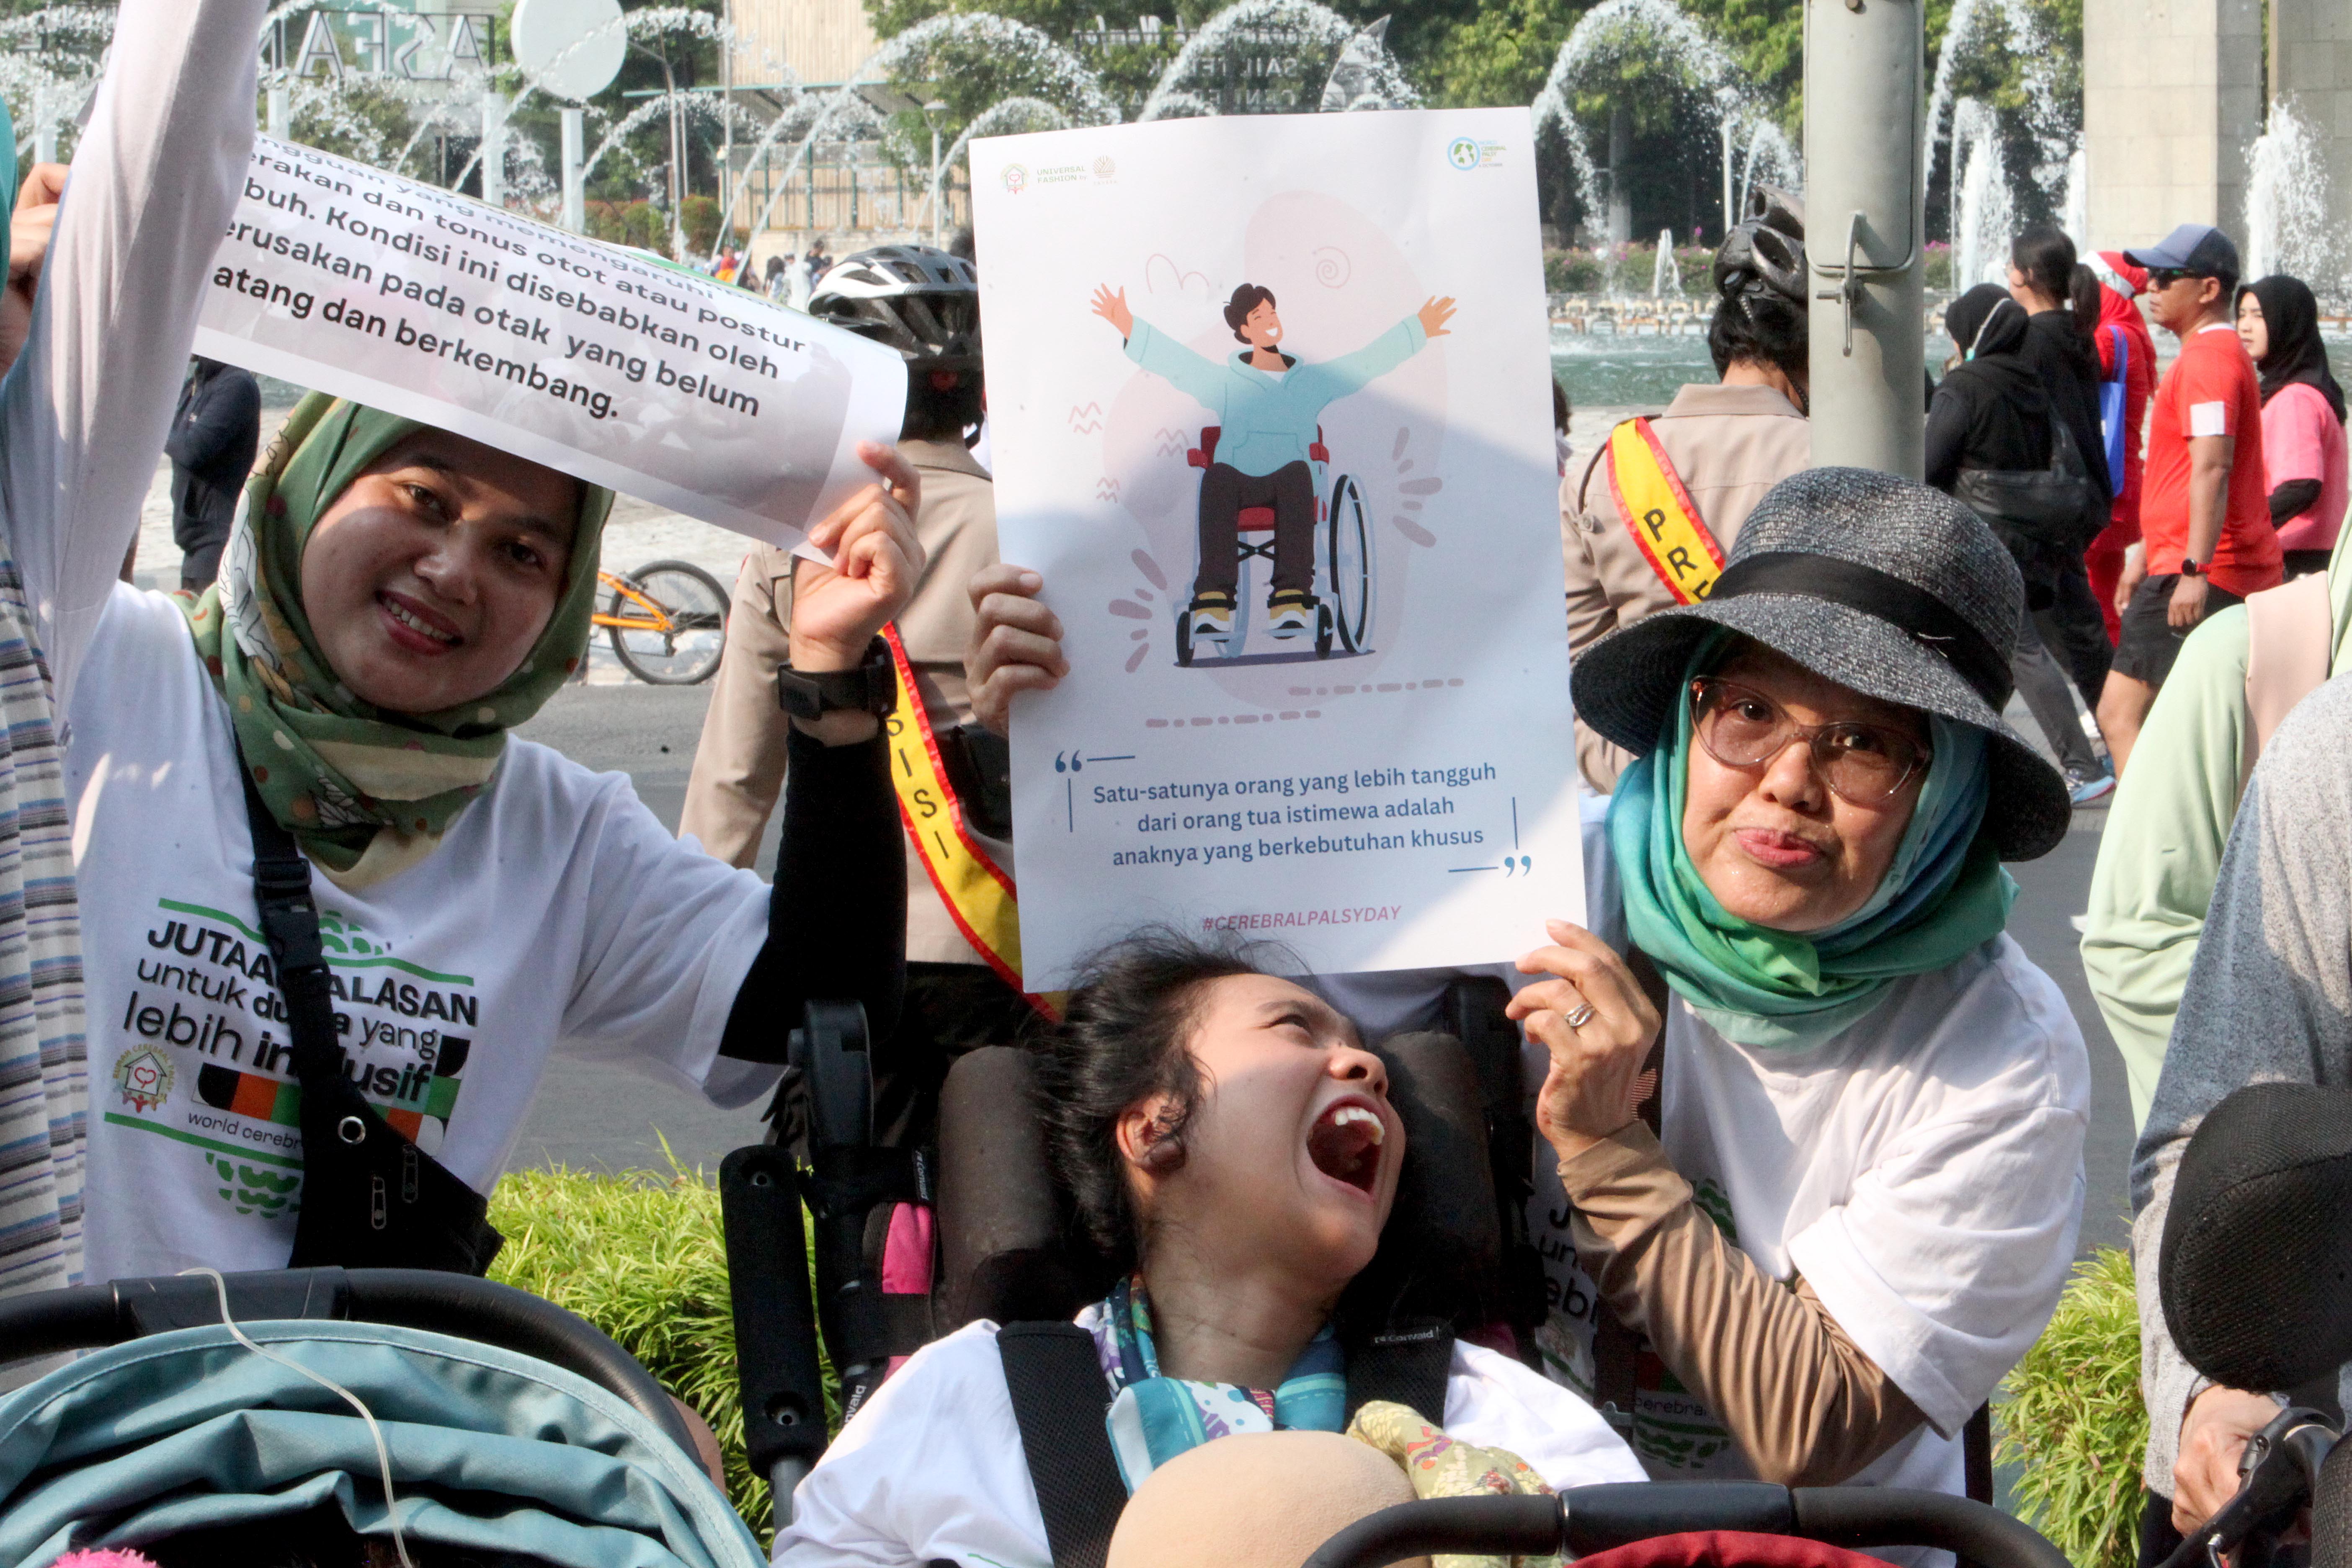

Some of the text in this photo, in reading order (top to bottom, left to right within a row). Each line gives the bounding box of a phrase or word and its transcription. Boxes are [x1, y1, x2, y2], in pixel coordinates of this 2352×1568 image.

[1037, 165, 1086, 175] UNIVERSAL
[1037, 175, 1077, 183] FASHION
[255, 137, 714, 299] ngguan yang memengaruhi
[244, 176, 315, 220] buh.
[325, 206, 452, 266] Kondisi
[458, 250, 500, 283] ini
[506, 271, 700, 353] disebabkan
[709, 345, 779, 379] oleh
[363, 186, 424, 221] dan
[433, 213, 529, 256] tonus
[536, 252, 607, 285] otot
[615, 280, 689, 313] atau
[698, 306, 807, 353] postur
[213, 266, 618, 419] atang dan berkembang.
[379, 272, 465, 317] pada
[474, 308, 551, 345] otak
[565, 334, 647, 382] yang
[655, 359, 759, 417] belum
[1093, 762, 1497, 804] Satu-satunya orang yang lebih tangguh
[1137, 796, 1455, 832] dari orang tua istimewa adalah
[1113, 828, 1484, 867] anaknya yang berkebutuhan khusus
[1202, 905, 1402, 932] #CEREBRALPALSYDAY
[147, 921, 275, 988] JUTAA
[137, 957, 248, 1010] untuk
[359, 1016, 438, 1061] yang
[123, 991, 434, 1102] lebih inusif
[188, 1112, 302, 1149] world cerebr
